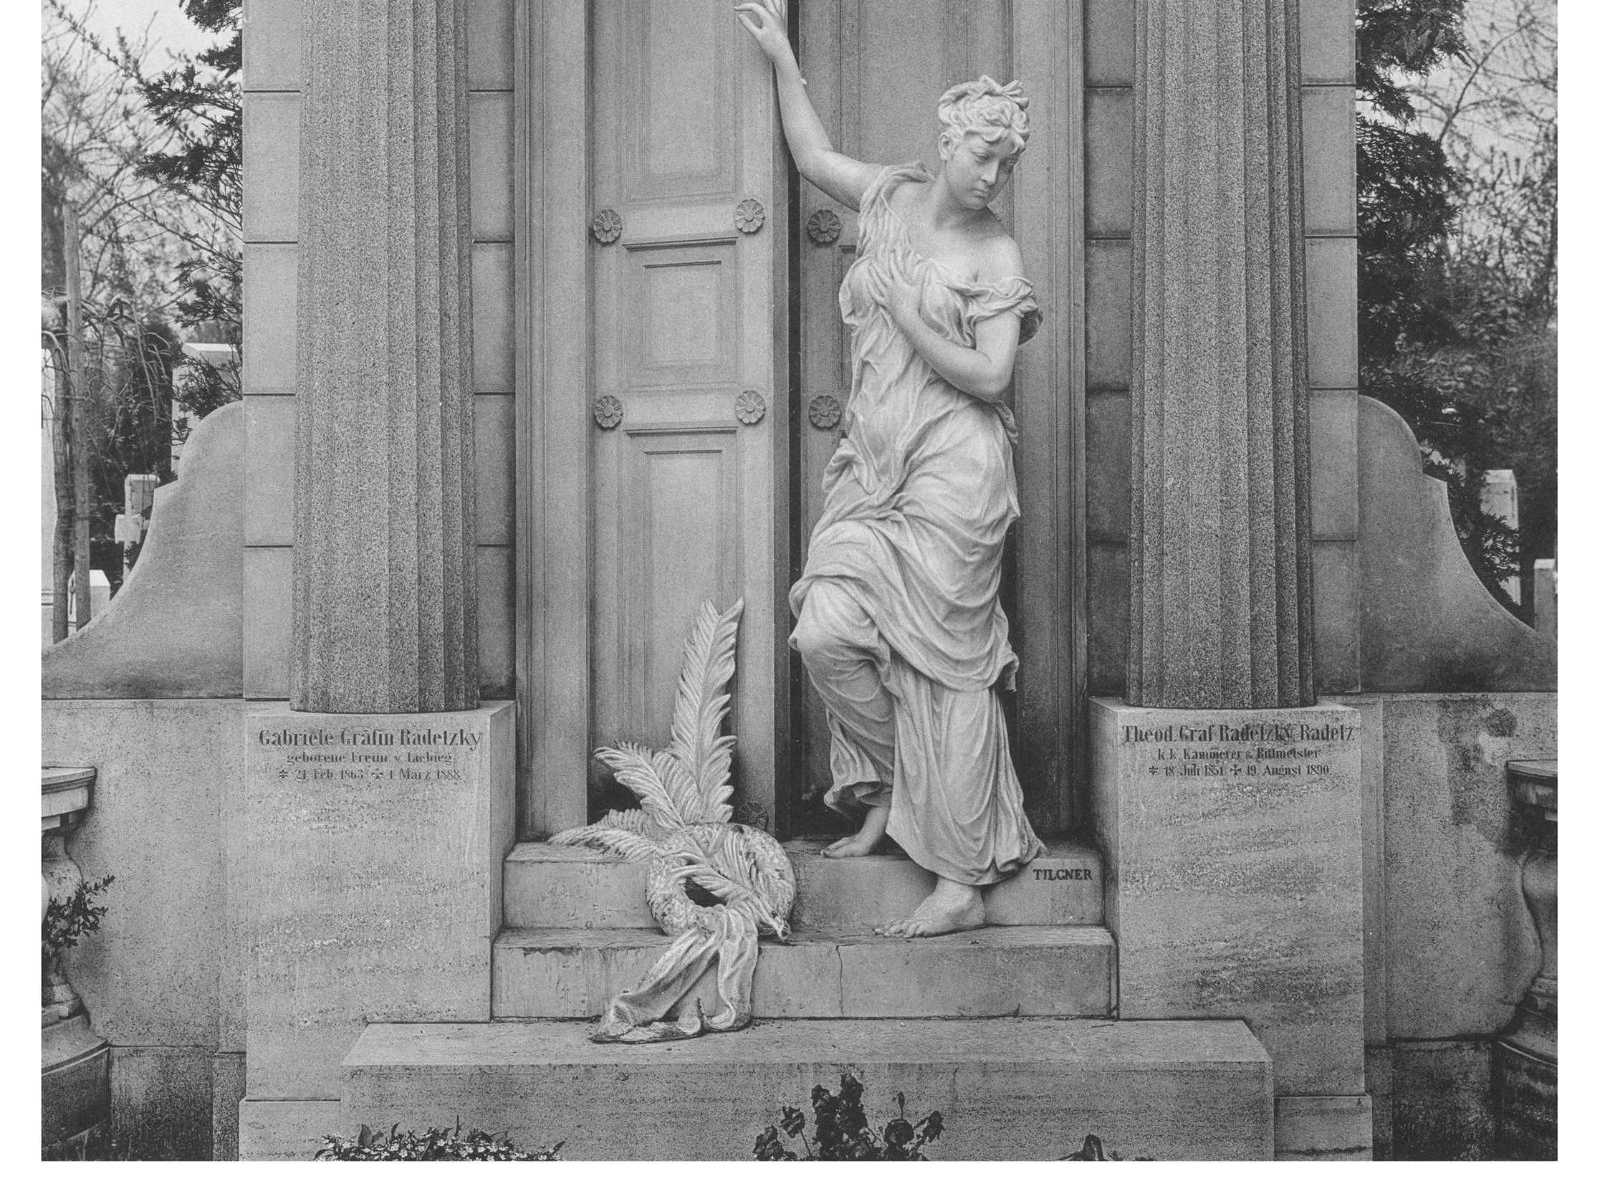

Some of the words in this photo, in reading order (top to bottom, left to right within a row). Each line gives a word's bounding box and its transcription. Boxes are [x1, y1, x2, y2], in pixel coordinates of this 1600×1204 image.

[259, 729, 334, 746] Gabriele
[400, 728, 483, 751] Radetzky
[1179, 724, 1215, 742] Graf
[286, 751, 346, 766] geborene
[1033, 869, 1093, 881] TILGNER
